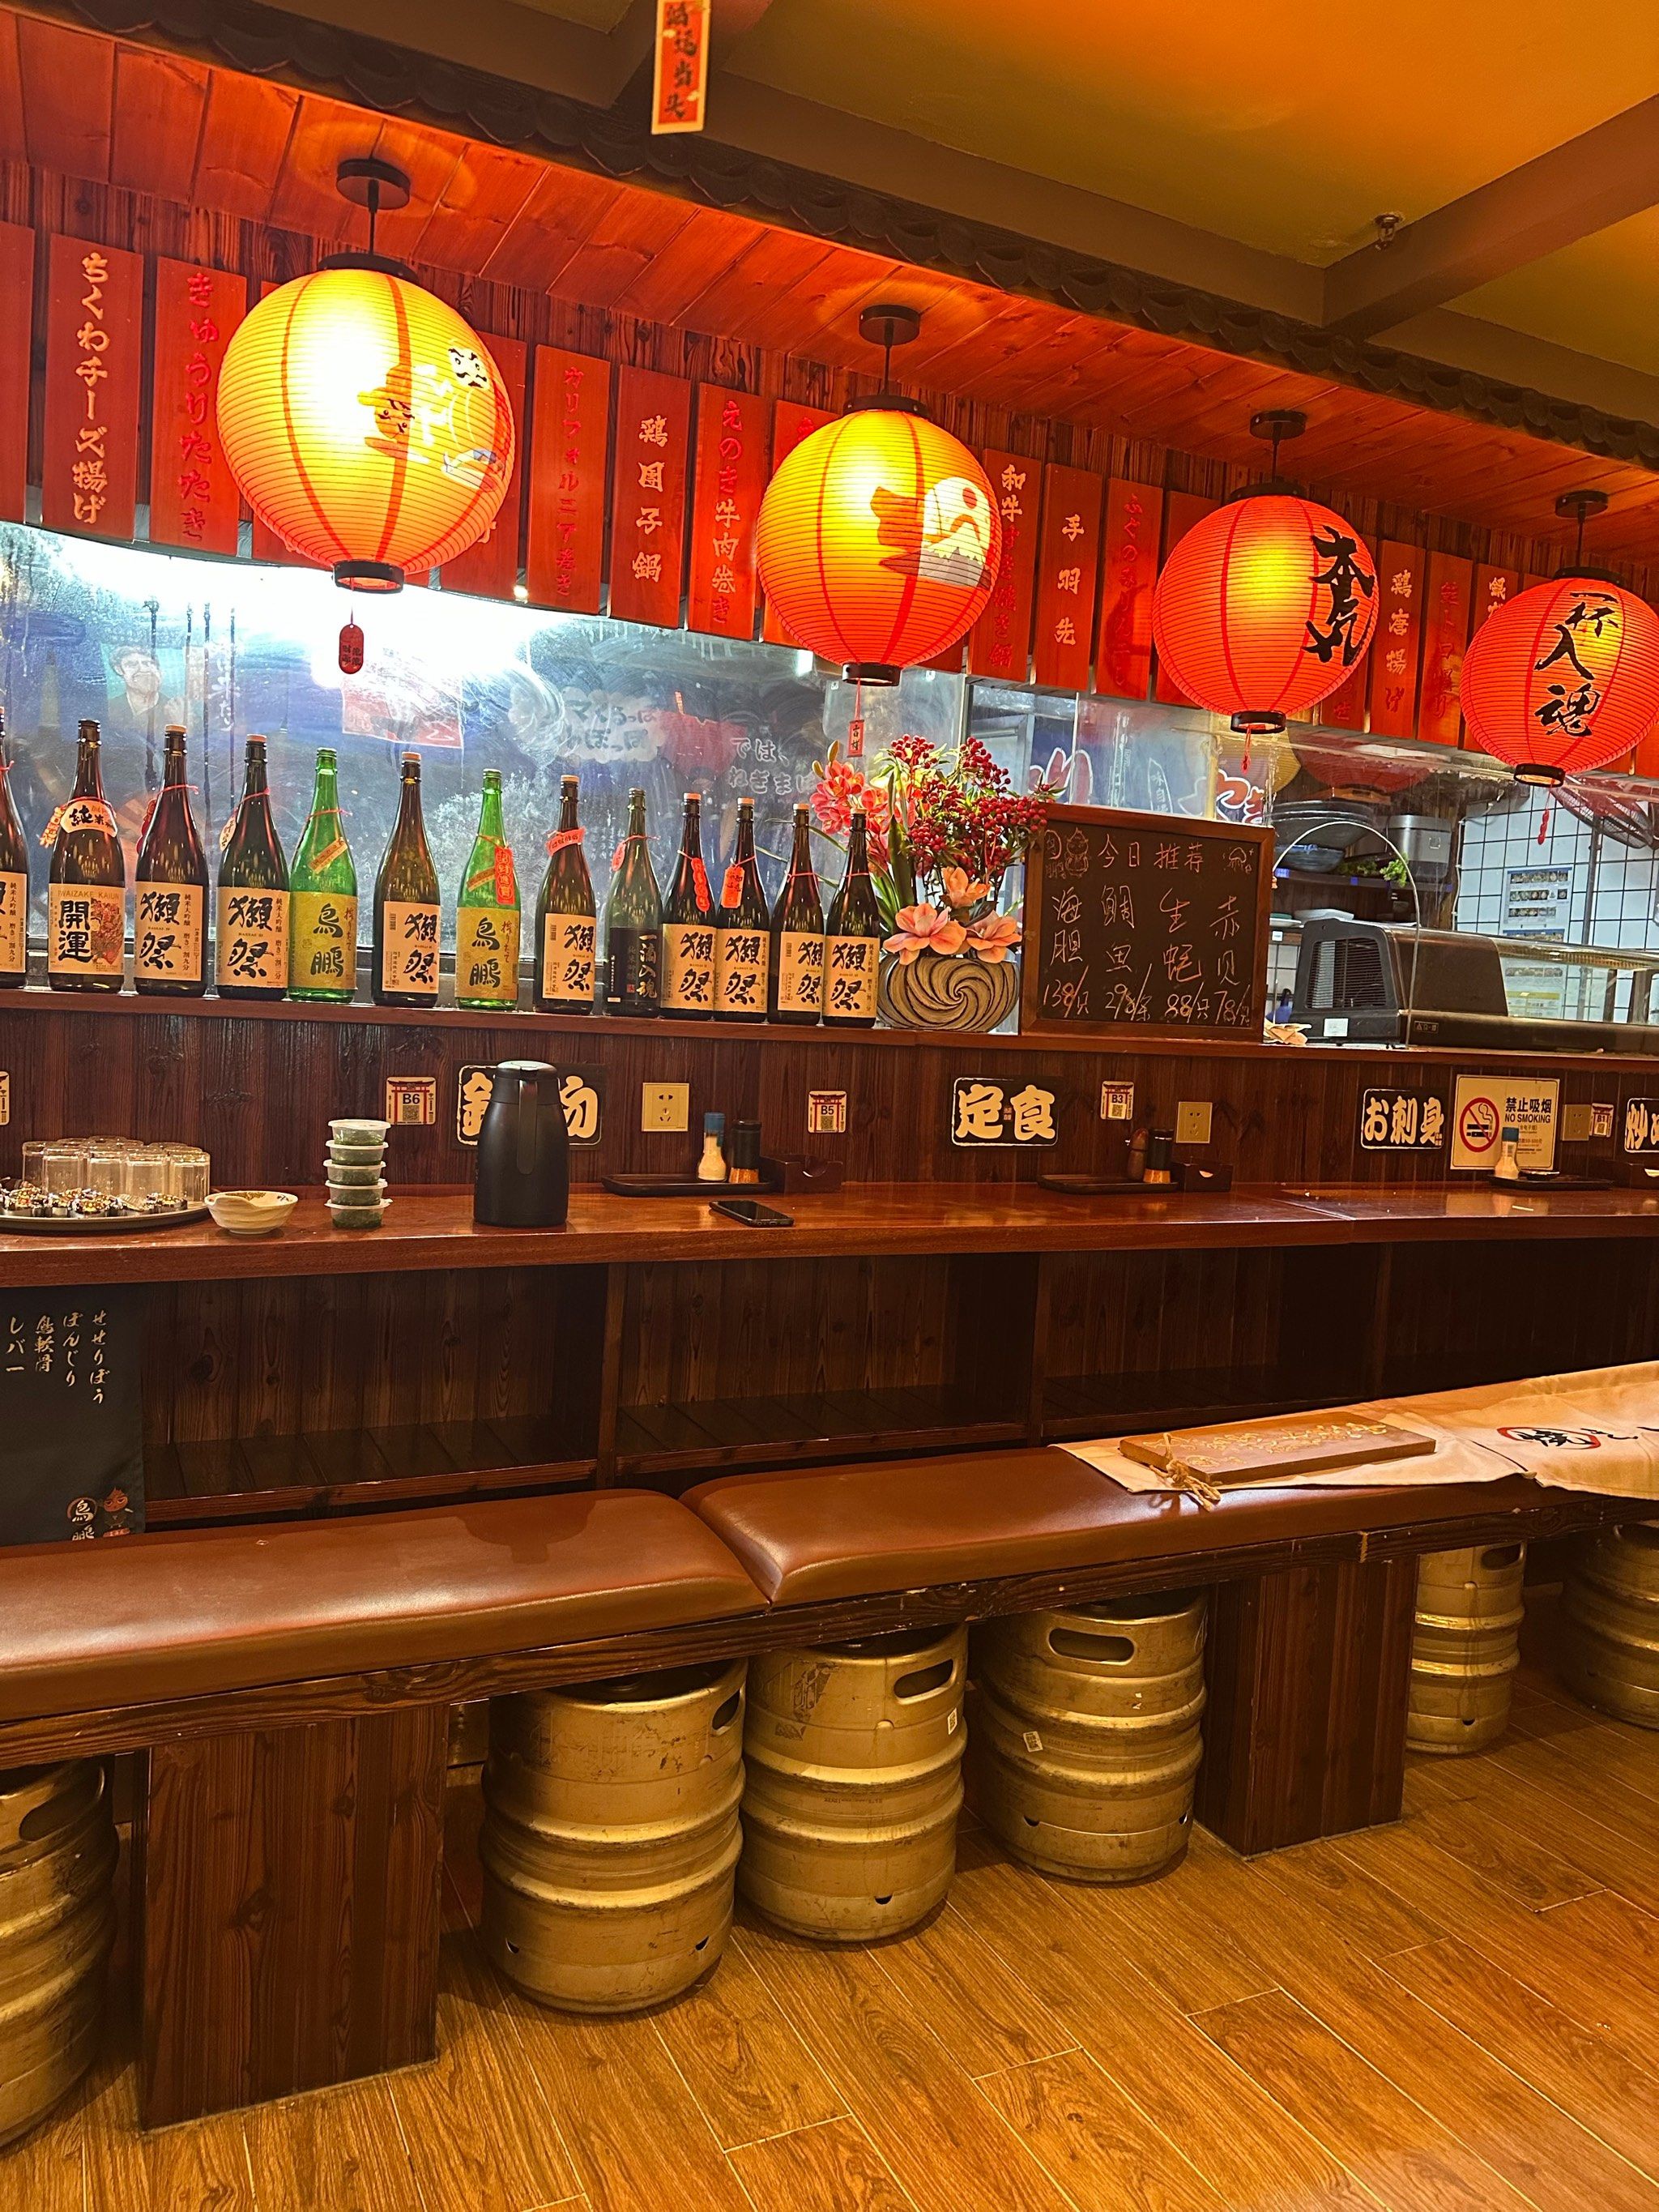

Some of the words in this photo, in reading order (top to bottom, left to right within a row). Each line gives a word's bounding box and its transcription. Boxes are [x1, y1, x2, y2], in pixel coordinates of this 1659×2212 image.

[71, 250, 111, 525] ちくわチーズ揚げ
[175, 271, 220, 541] きゅうりたたき
[710, 399, 744, 626] えのき牛肉巻き
[1533, 591, 1620, 737] 一杯入魂
[1097, 833, 1205, 873] 今日推荐
[58, 900, 95, 963] 開運
[139, 890, 182, 970] 獺祭
[227, 895, 275, 979] 獺祭
[403, 912, 437, 984] 獺祭
[561, 924, 595, 992] 獺祭
[1050, 886, 1084, 967] 海胆
[1209, 895, 1240, 986] 赤贝
[678, 932, 714, 1003] 獺祭
[723, 934, 761, 1006] 獺祭
[830, 942, 868, 1011] 獺祭
[402, 1093, 420, 1104] B6
[821, 1104, 835, 1116] B5
[956, 1083, 1056, 1141] 定食
[1111, 1094, 1124, 1104] B3
[1364, 1095, 1444, 1145] お刺身
[1504, 1112, 1516, 1123] NO
[1516, 1113, 1551, 1124] SMOKING
[1505, 1096, 1552, 1114] 禁止吸烟
